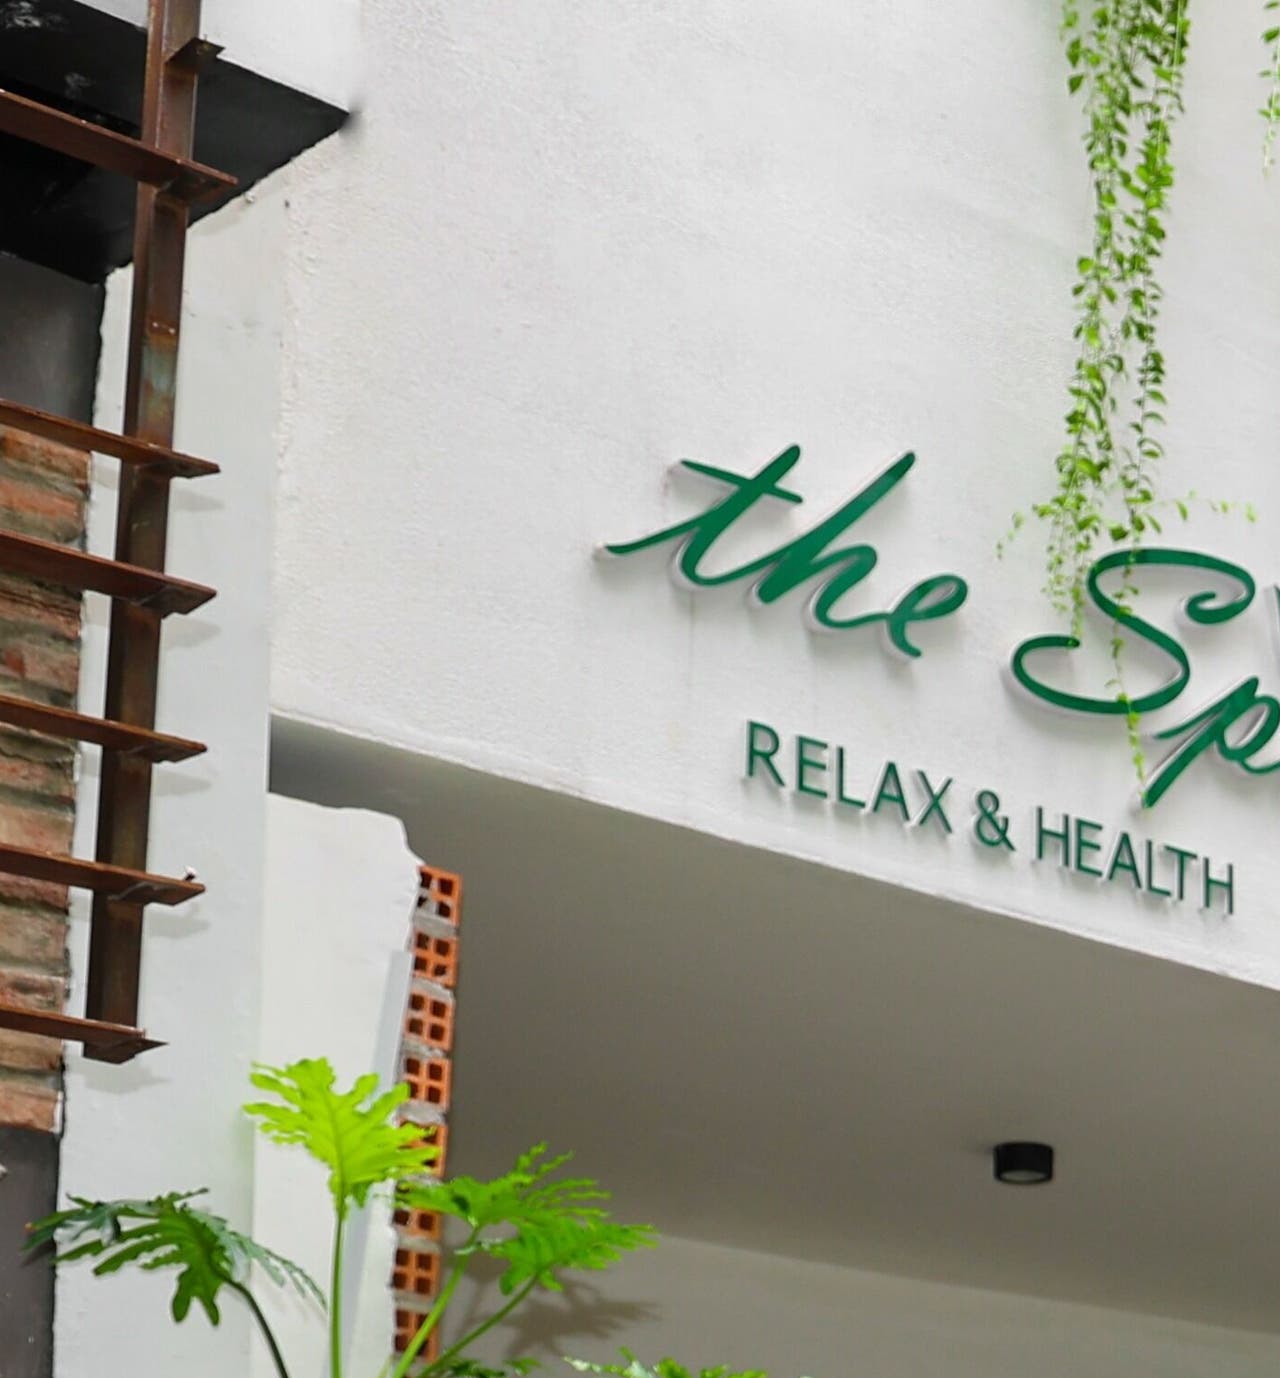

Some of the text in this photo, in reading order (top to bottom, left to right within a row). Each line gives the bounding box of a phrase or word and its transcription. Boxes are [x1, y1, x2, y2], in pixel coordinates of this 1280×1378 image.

[603, 444, 968, 658] the
[745, 719, 1236, 914] RELAX & HEALTH
